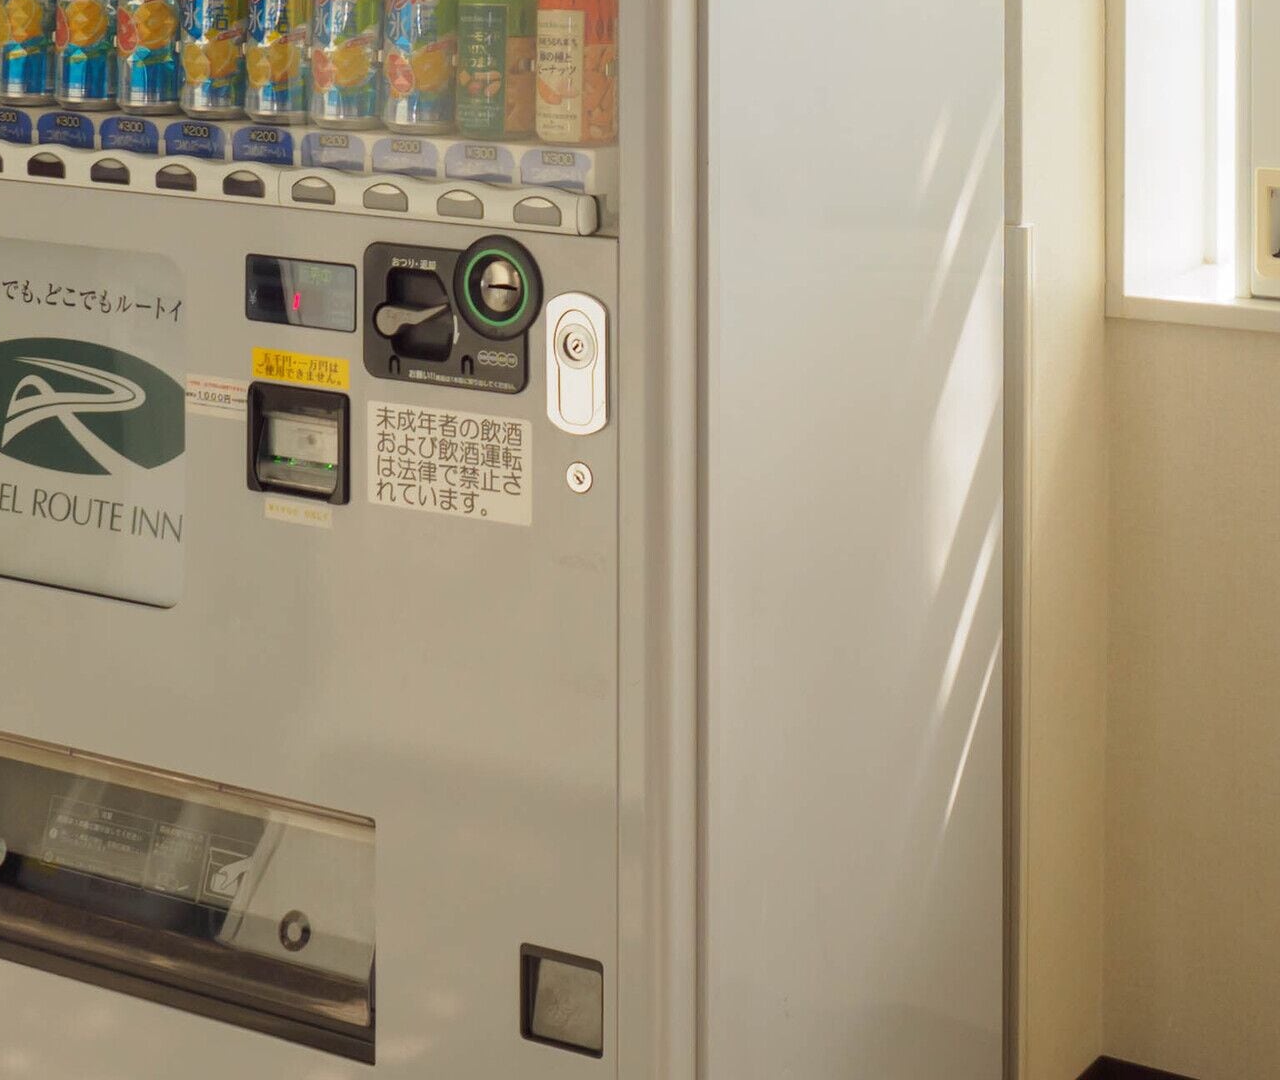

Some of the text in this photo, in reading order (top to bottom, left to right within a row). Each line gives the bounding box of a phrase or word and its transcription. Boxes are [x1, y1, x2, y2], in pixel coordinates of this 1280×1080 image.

[183, 124, 209, 137] ¥200
[250, 129, 277, 143] ¥200
[376, 406, 523, 447] 未成年者の飲酒
[377, 431, 523, 472] および飲酒運転
[377, 455, 523, 496] は法律で禁止さ
[32, 488, 124, 532] ROUTE
[131, 505, 184, 544] INN
[376, 478, 488, 517] れています。
